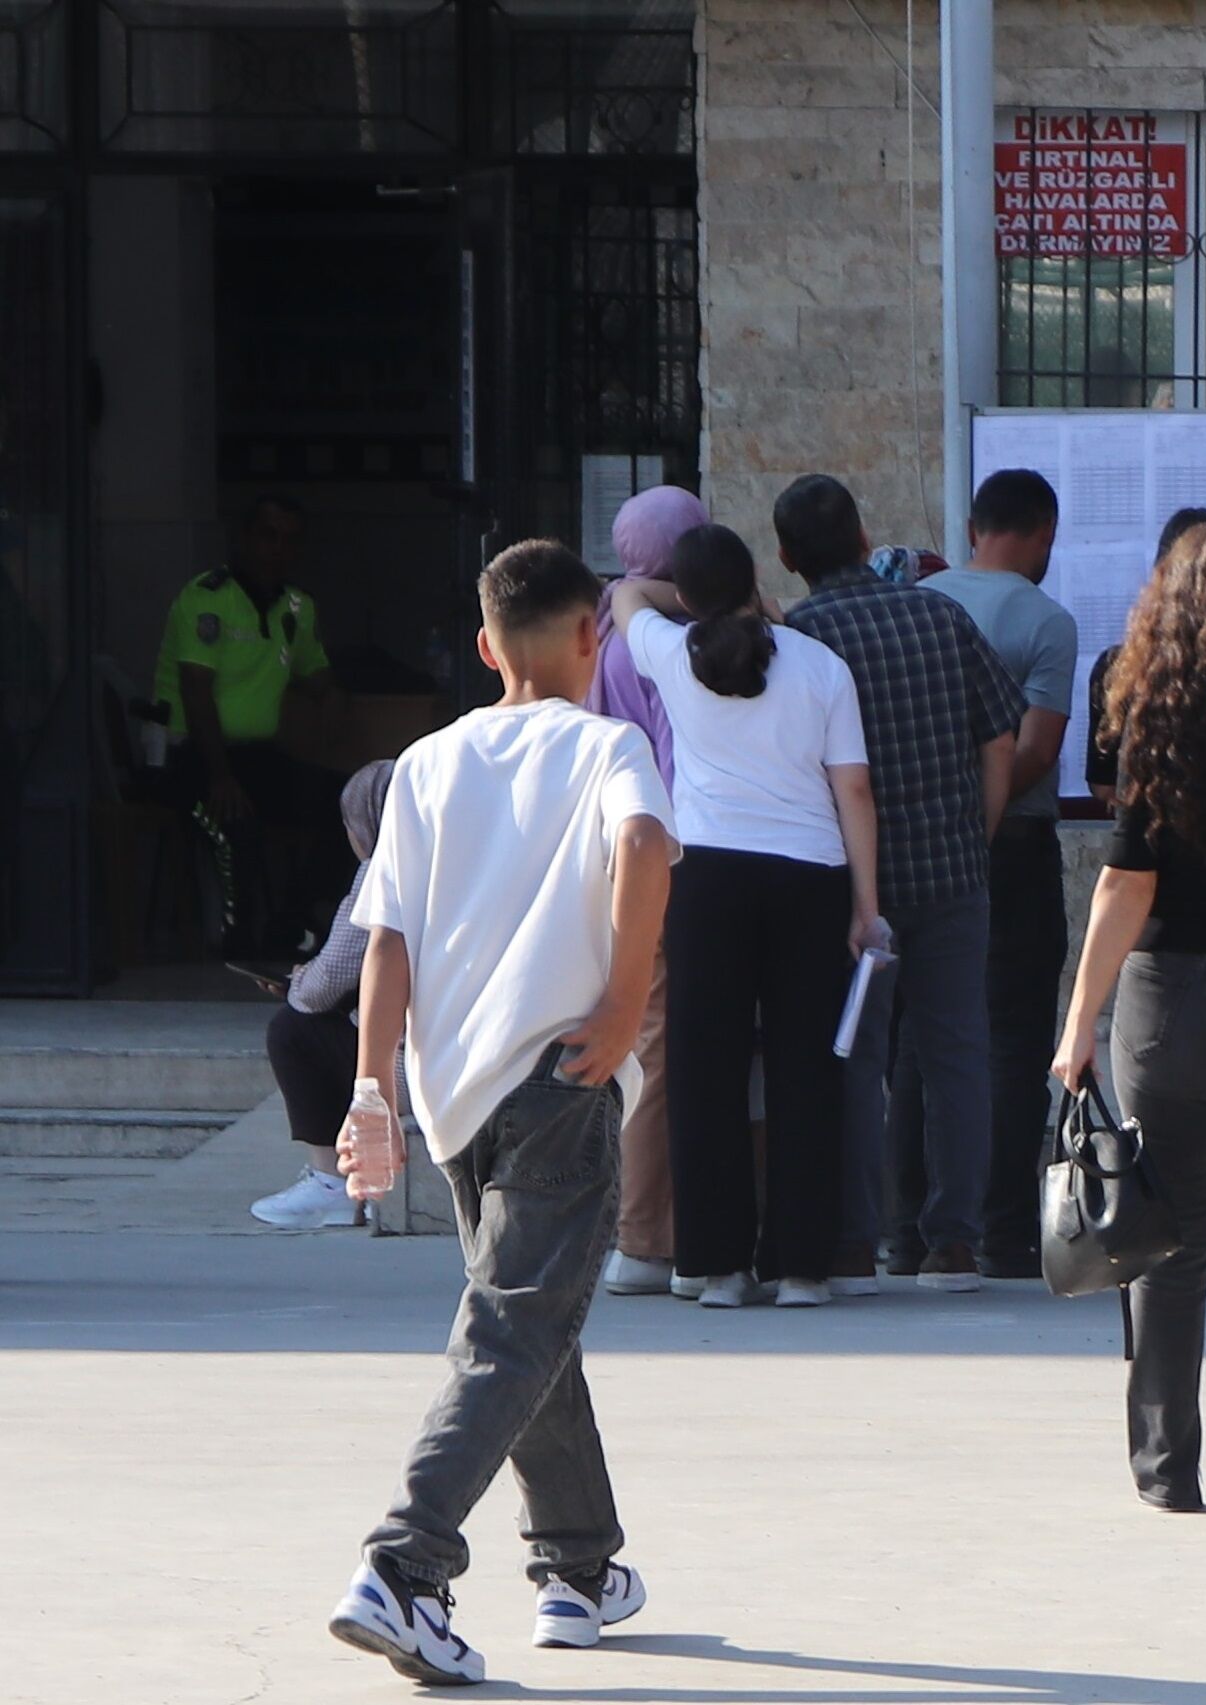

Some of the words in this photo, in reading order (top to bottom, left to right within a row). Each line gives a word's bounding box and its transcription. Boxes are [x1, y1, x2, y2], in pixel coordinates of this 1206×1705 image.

[995, 171, 1030, 188] VE
[1004, 192, 1168, 210] HAVALARDA
[1062, 213, 1180, 231] ALTINDA
